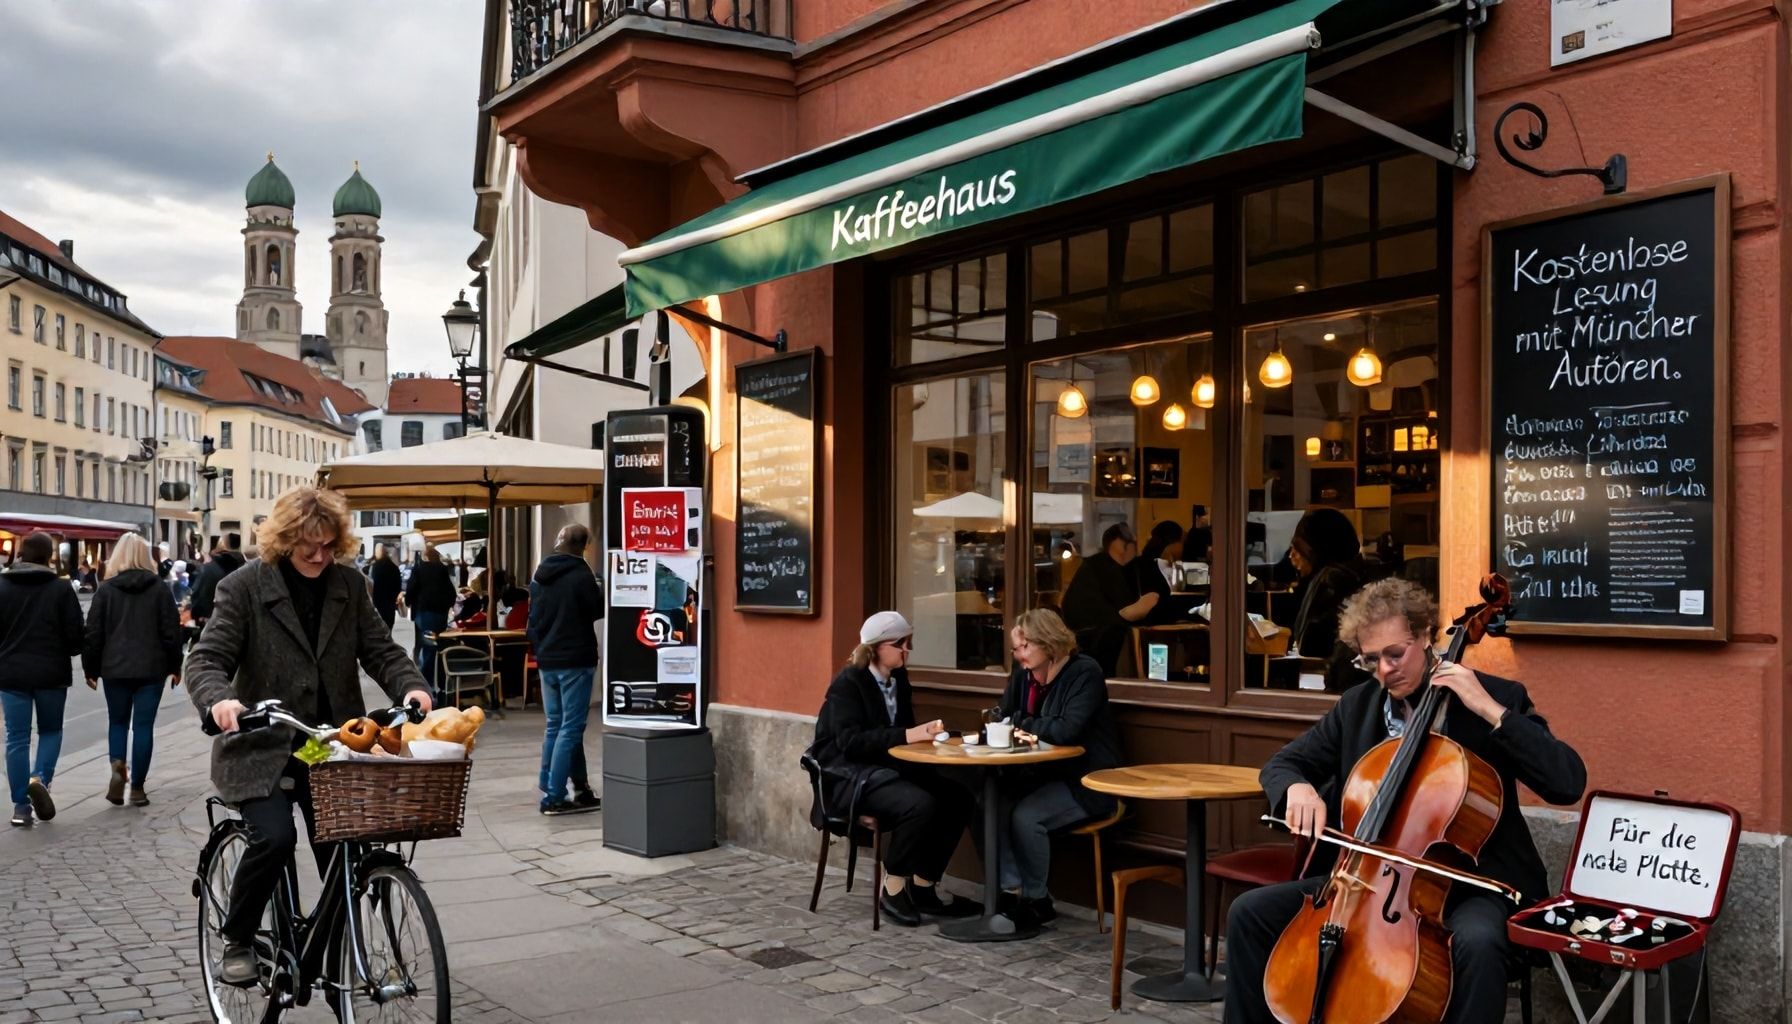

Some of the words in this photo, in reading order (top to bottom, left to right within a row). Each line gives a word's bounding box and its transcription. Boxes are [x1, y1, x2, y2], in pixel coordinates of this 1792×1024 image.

[831, 169, 1017, 250] Kaffeehaus
[1516, 324, 1563, 353] mit
[1609, 817, 1651, 844] Für
[1661, 823, 1697, 851] die
